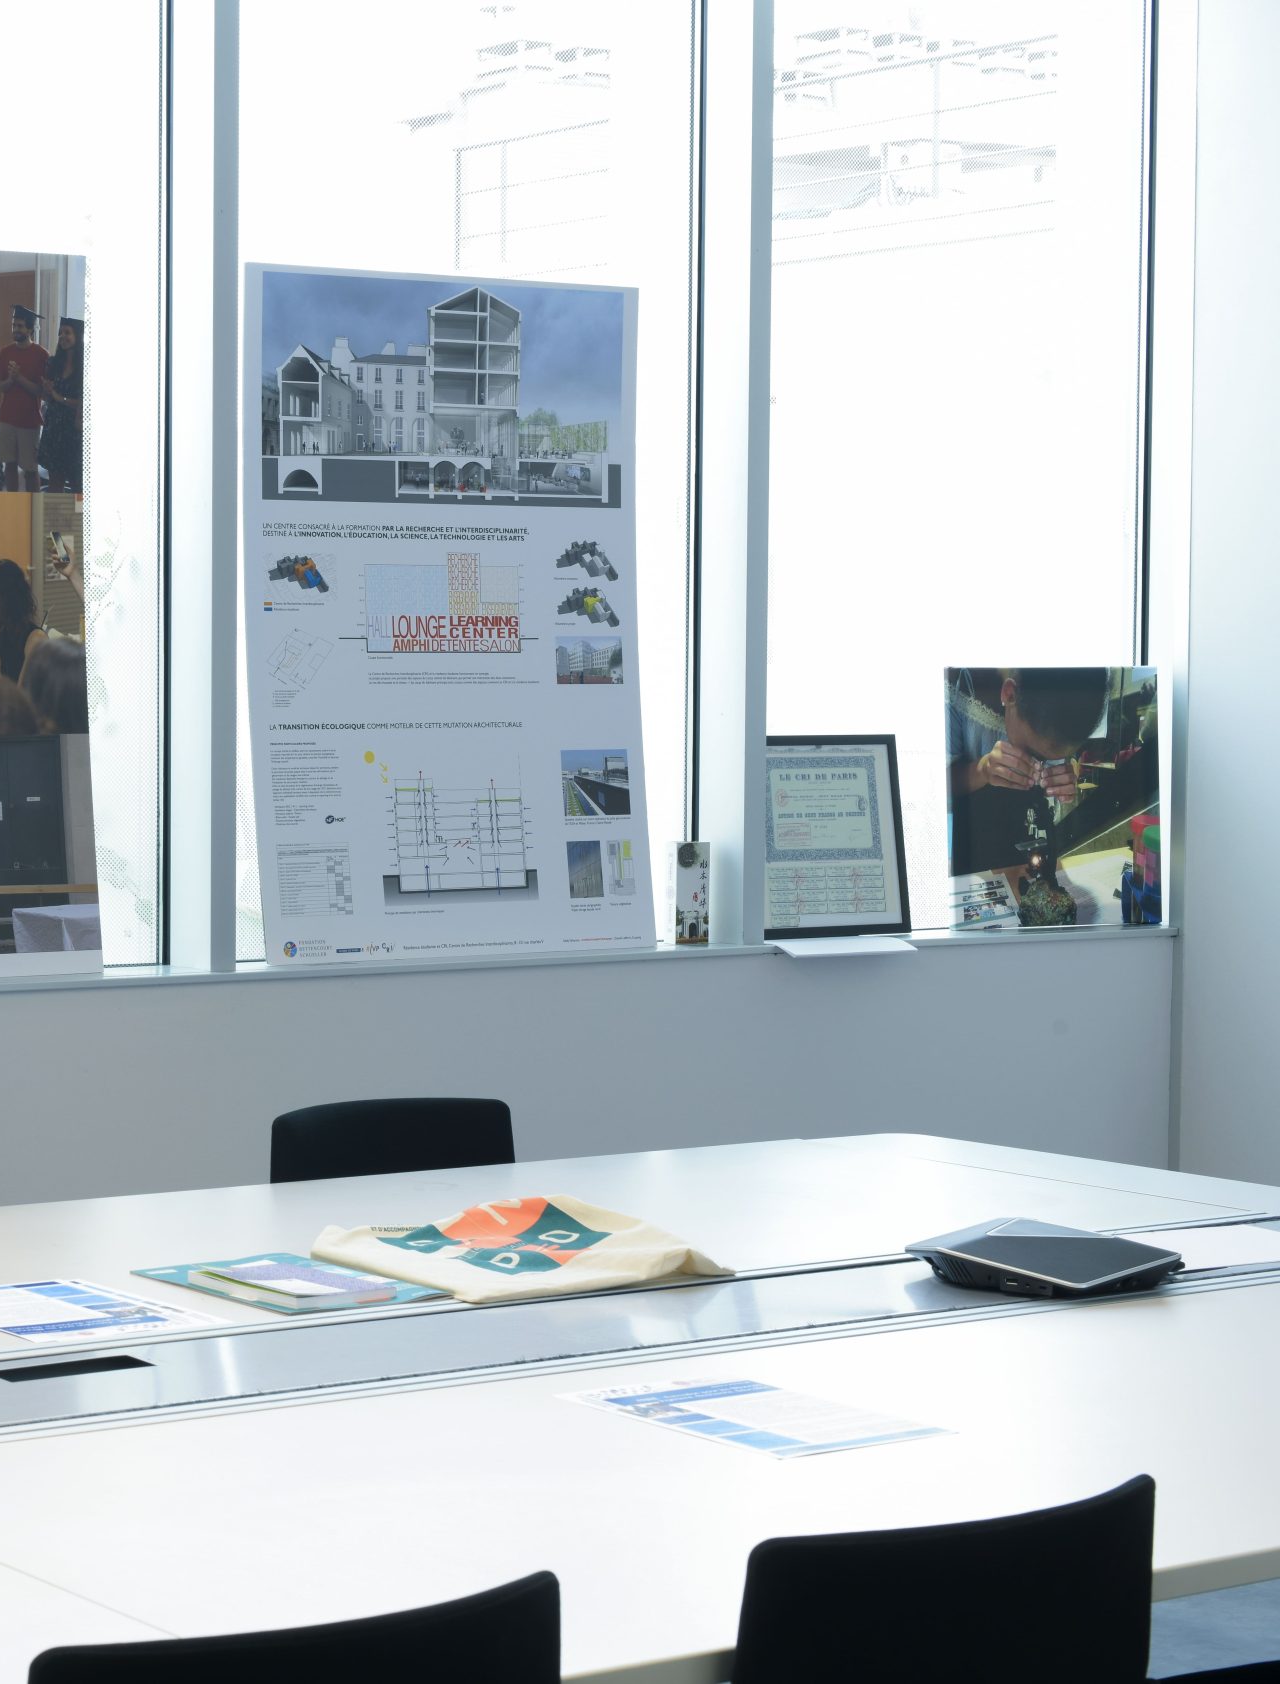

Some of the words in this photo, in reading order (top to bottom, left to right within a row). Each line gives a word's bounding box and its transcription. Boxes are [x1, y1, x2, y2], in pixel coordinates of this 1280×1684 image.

[440, 533, 486, 541] TECHNOLOGIE
[367, 616, 391, 639] HALL
[391, 615, 447, 639] LOUNGE
[449, 615, 519, 628] LEARNING
[449, 627, 519, 639] CENTER
[393, 639, 430, 652] AMPHI
[367, 722, 389, 730] COMME
[443, 721, 472, 729] MUTATION
